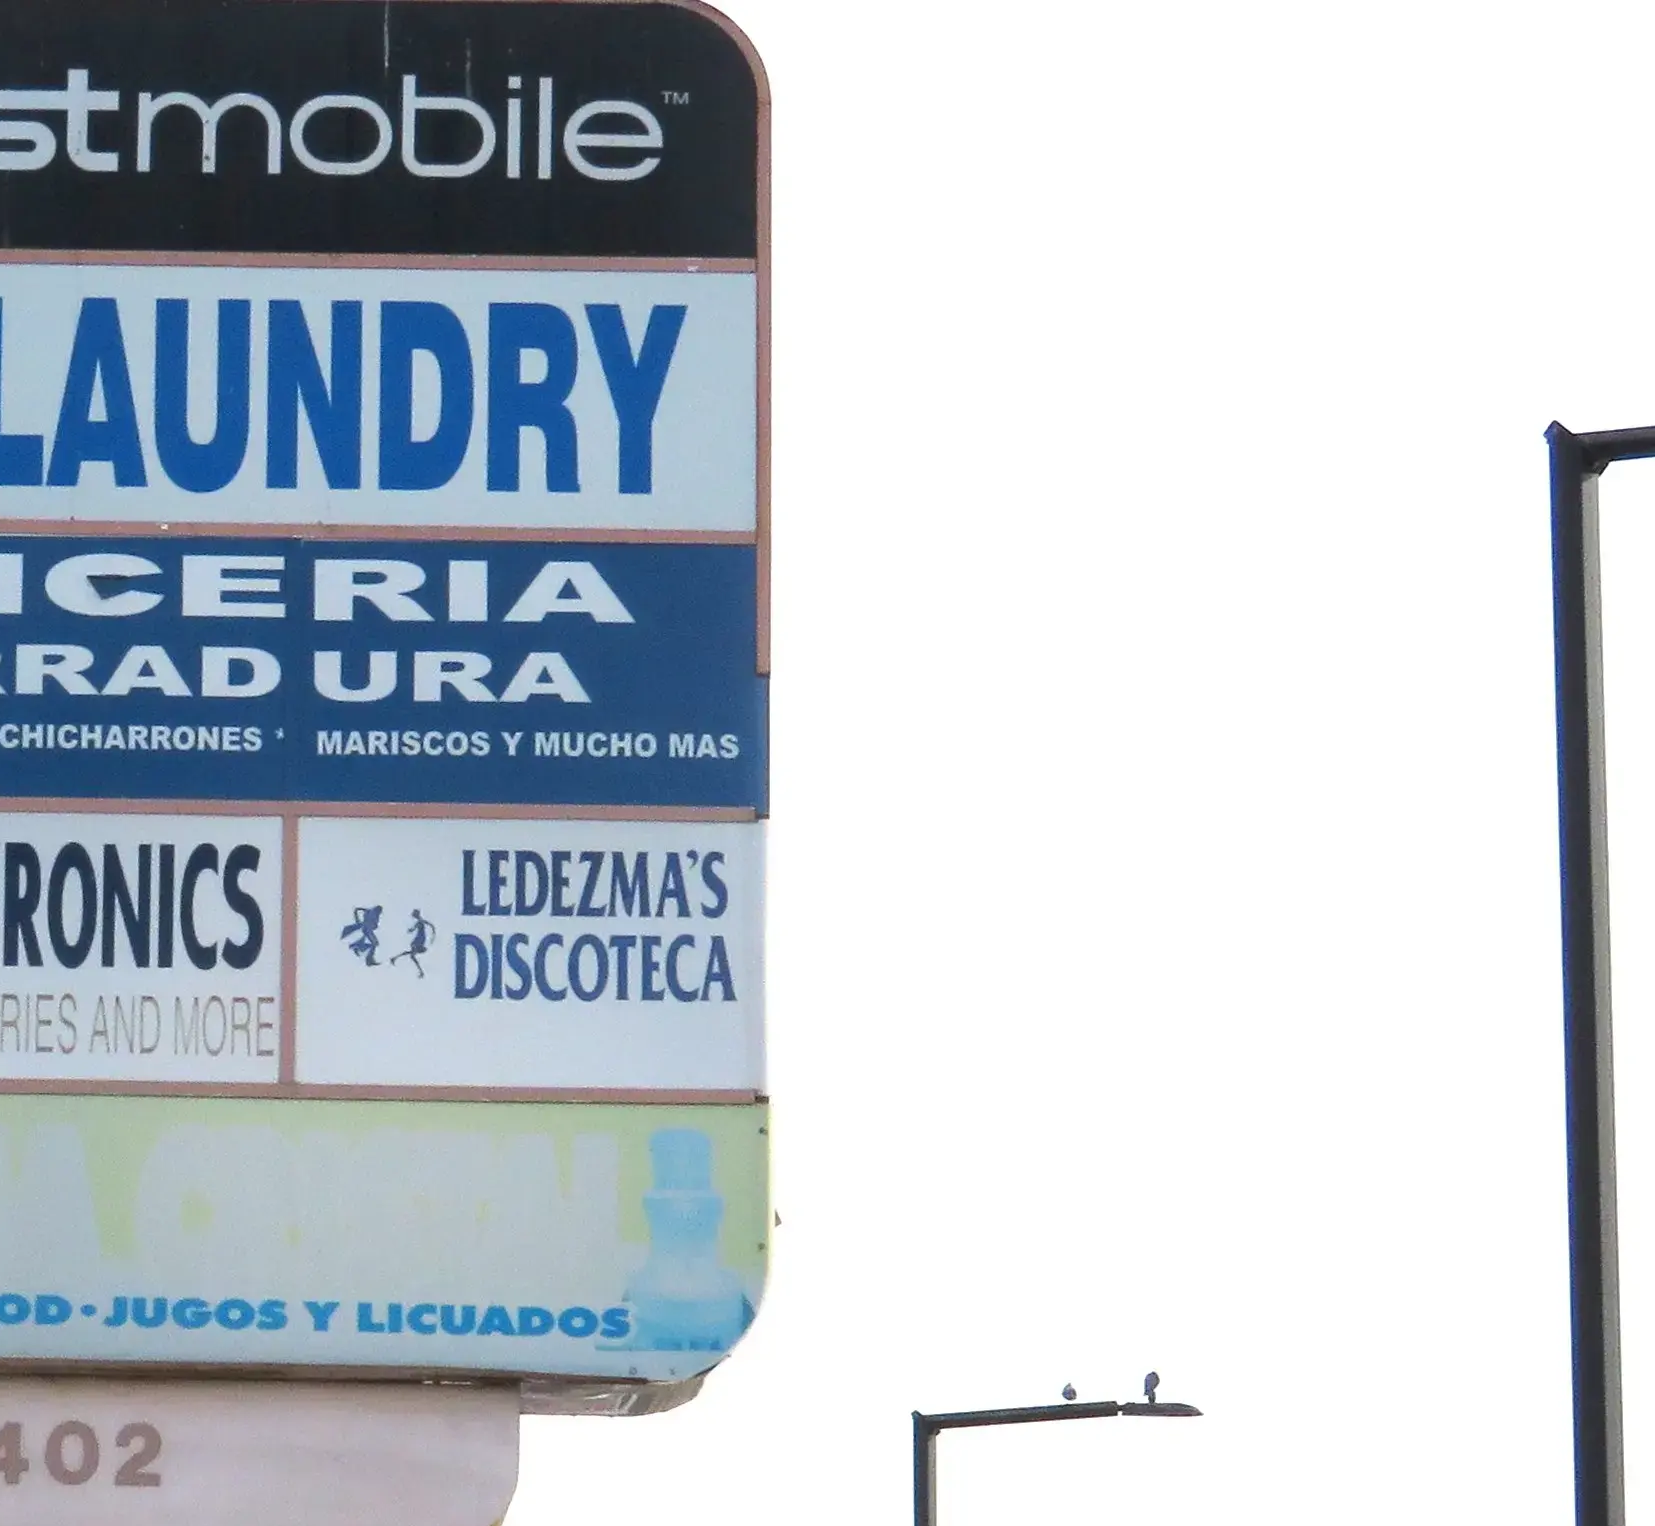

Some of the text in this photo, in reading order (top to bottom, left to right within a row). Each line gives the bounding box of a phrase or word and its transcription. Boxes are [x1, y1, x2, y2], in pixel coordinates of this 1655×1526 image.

[316, 730, 490, 757] MARISCOS
[500, 732, 524, 756] Y
[534, 732, 657, 758] MUCHO
[669, 734, 740, 760] MAS
[460, 848, 728, 918] LEDEZMA'S
[453, 933, 738, 1002] DISCOTECA
[88, 995, 161, 1055] AND
[173, 995, 276, 1057] MORE
[303, 1300, 340, 1332] Y
[356, 1304, 631, 1338] LICUADOS
